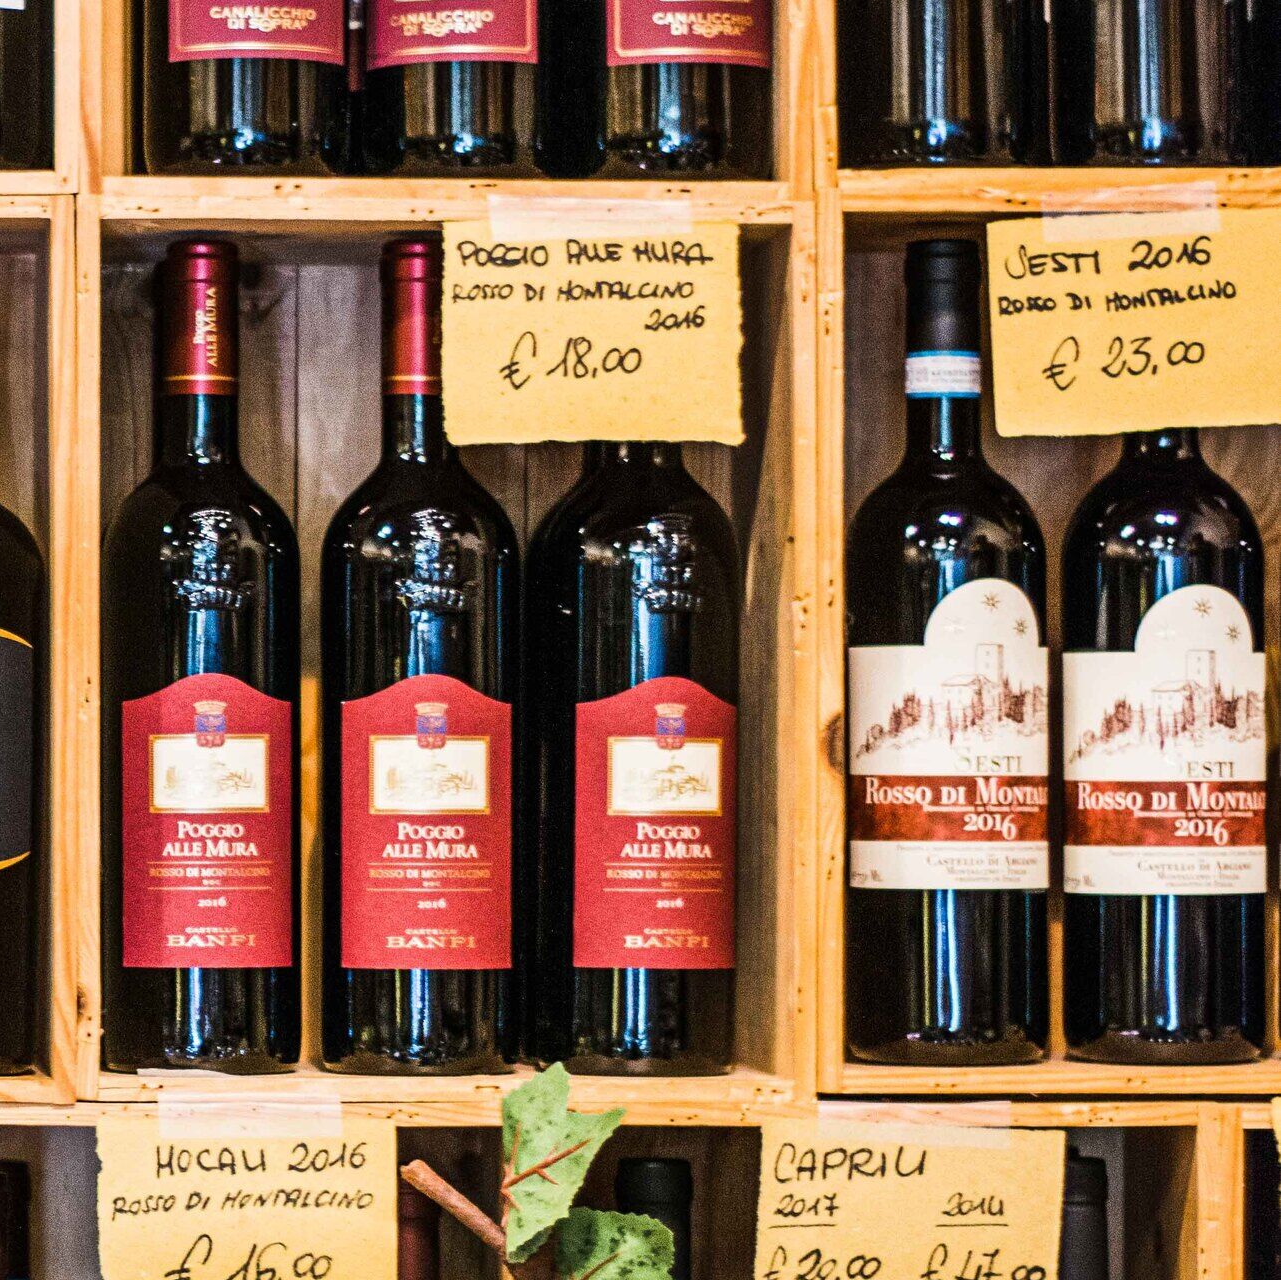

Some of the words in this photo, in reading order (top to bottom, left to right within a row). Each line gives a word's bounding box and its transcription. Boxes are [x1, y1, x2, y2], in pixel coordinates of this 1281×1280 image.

[457, 240, 549, 267] POGGIO
[1004, 244, 1101, 280] SESTI
[1128, 235, 1212, 271] 2016
[452, 282, 514, 304] ROSSO
[524, 282, 545, 302] DI
[556, 280, 694, 302] MONTALCINO
[997, 296, 1057, 317] ROSSO
[1065, 292, 1092, 311] DI
[1106, 279, 1237, 312] MONTALCINO
[644, 305, 706, 331] 2016
[865, 776, 932, 807] ROSSO
[942, 787, 966, 805] DI
[397, 821, 464, 840] POGGIO
[963, 813, 1017, 842] 2016
[382, 843, 423, 858] ALLE
[425, 840, 478, 858] MURA
[417, 898, 447, 909] 2016
[287, 1142, 368, 1173] 2016
[774, 1142, 927, 1183] CAPRILI
[111, 1196, 176, 1221] ROSSO
[185, 1192, 210, 1211] DI
[221, 1188, 374, 1212] MONTALCINO
[773, 1192, 840, 1218] 2017
[941, 1191, 1005, 1217] 2014
